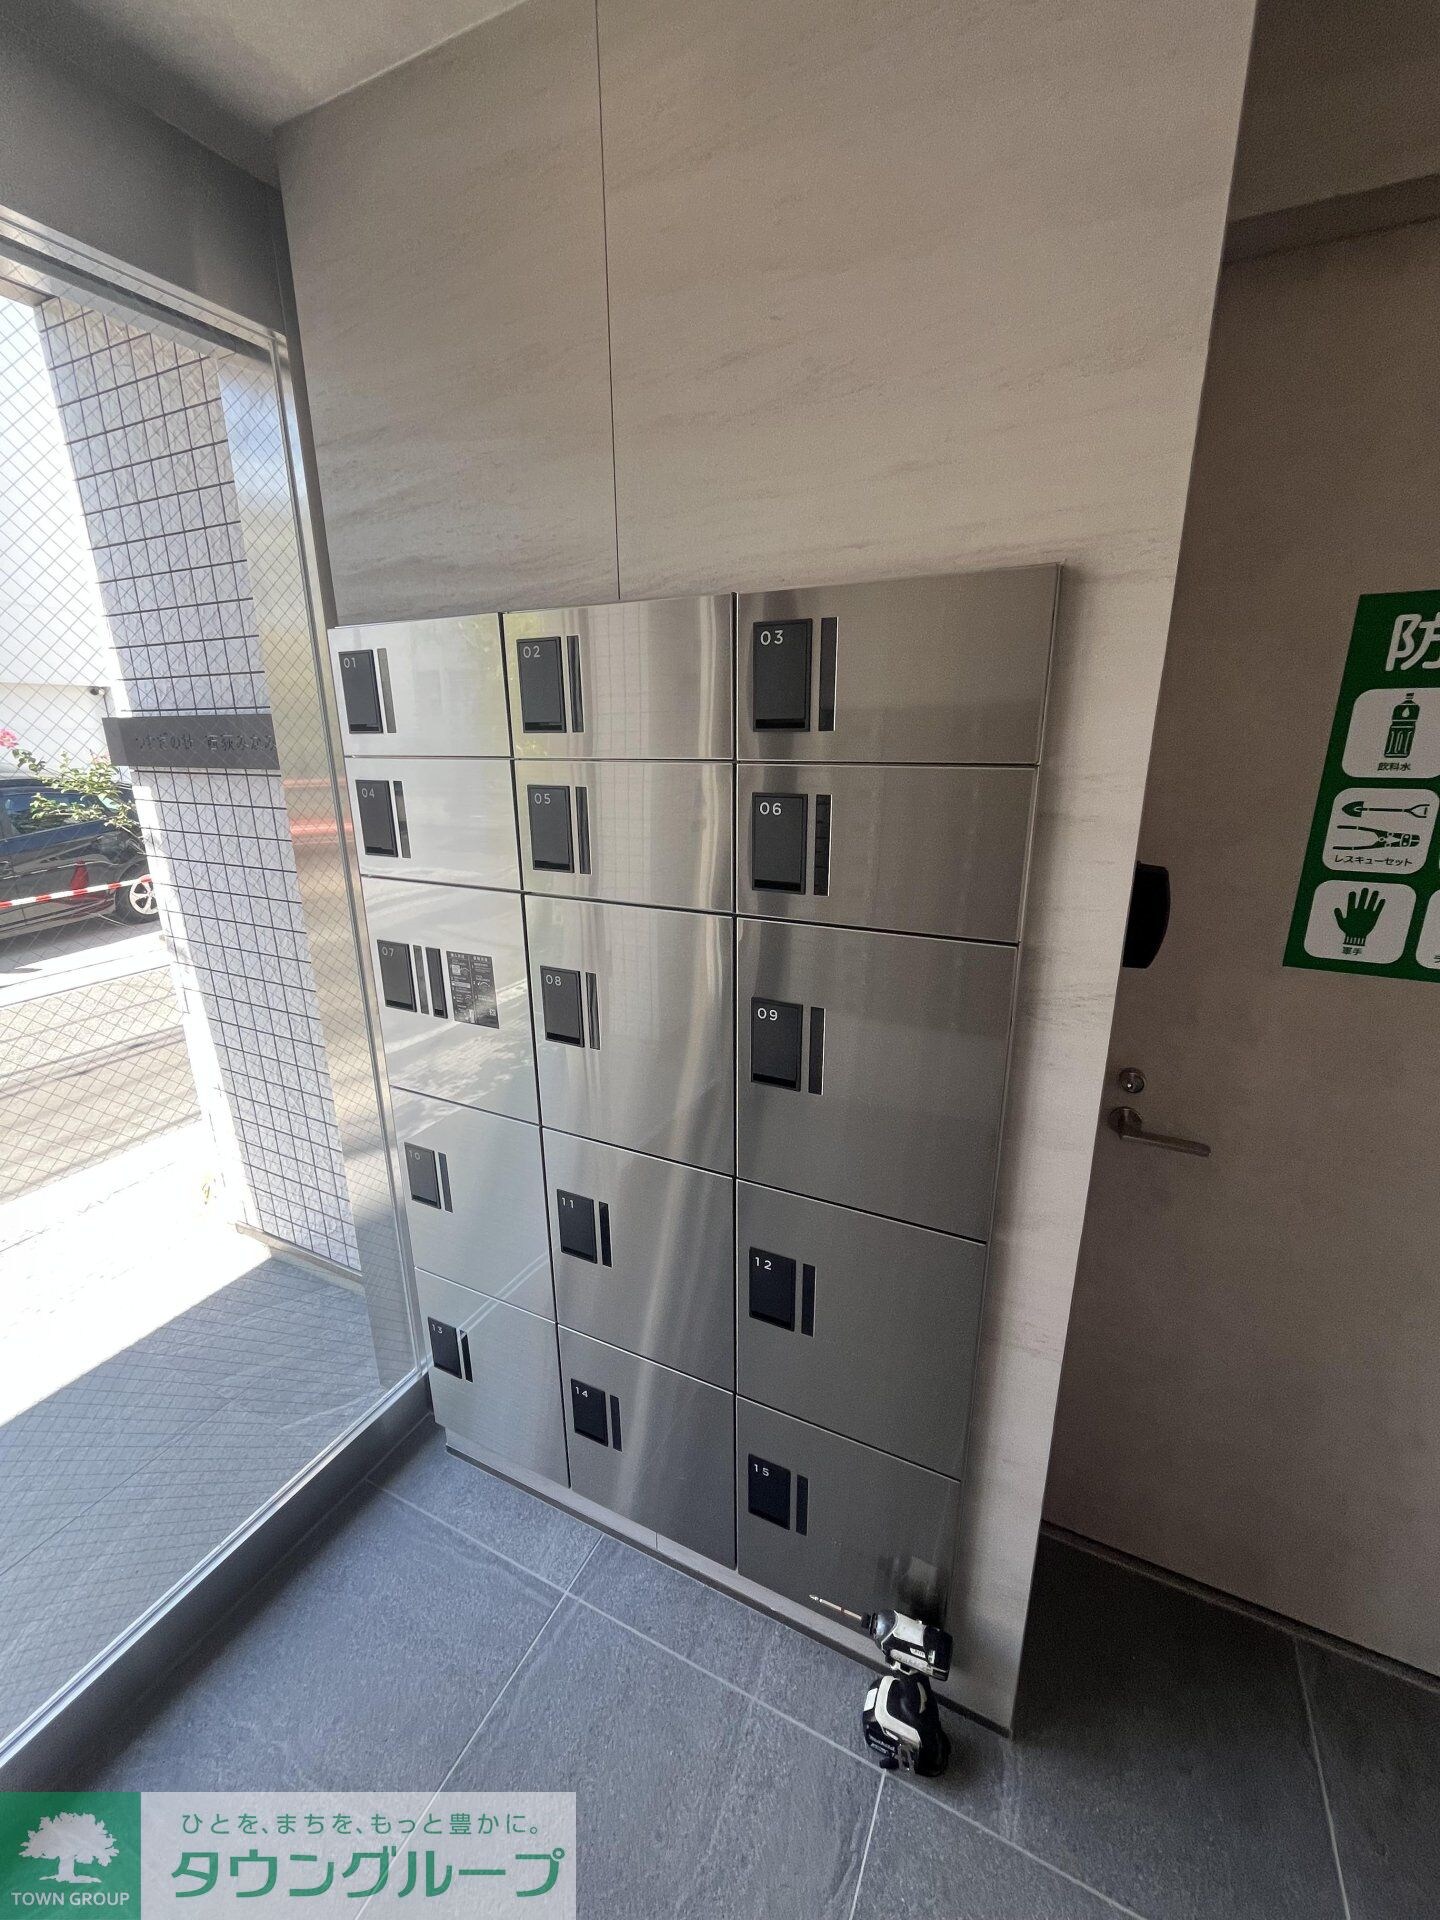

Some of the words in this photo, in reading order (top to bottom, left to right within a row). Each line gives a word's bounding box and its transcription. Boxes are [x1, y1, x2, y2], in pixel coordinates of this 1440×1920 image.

[760, 629, 784, 646] 03
[522, 645, 541, 659] 02
[343, 657, 357, 669] 01
[1377, 762, 1412, 772] 飲料水
[361, 787, 375, 799] 04
[534, 793, 551, 805] 05
[759, 802, 782, 816] 06
[1334, 854, 1413, 867] レスキューセット
[381, 946, 394, 957] 07
[545, 974, 562, 986] 08
[757, 1007, 778, 1021] 09
[408, 1149, 422, 1161] 10
[561, 1197, 574, 1209] 11
[754, 1256, 772, 1270] 12
[431, 1323, 443, 1335] 13
[575, 1386, 589, 1398] 14
[754, 1463, 770, 1477] 15
